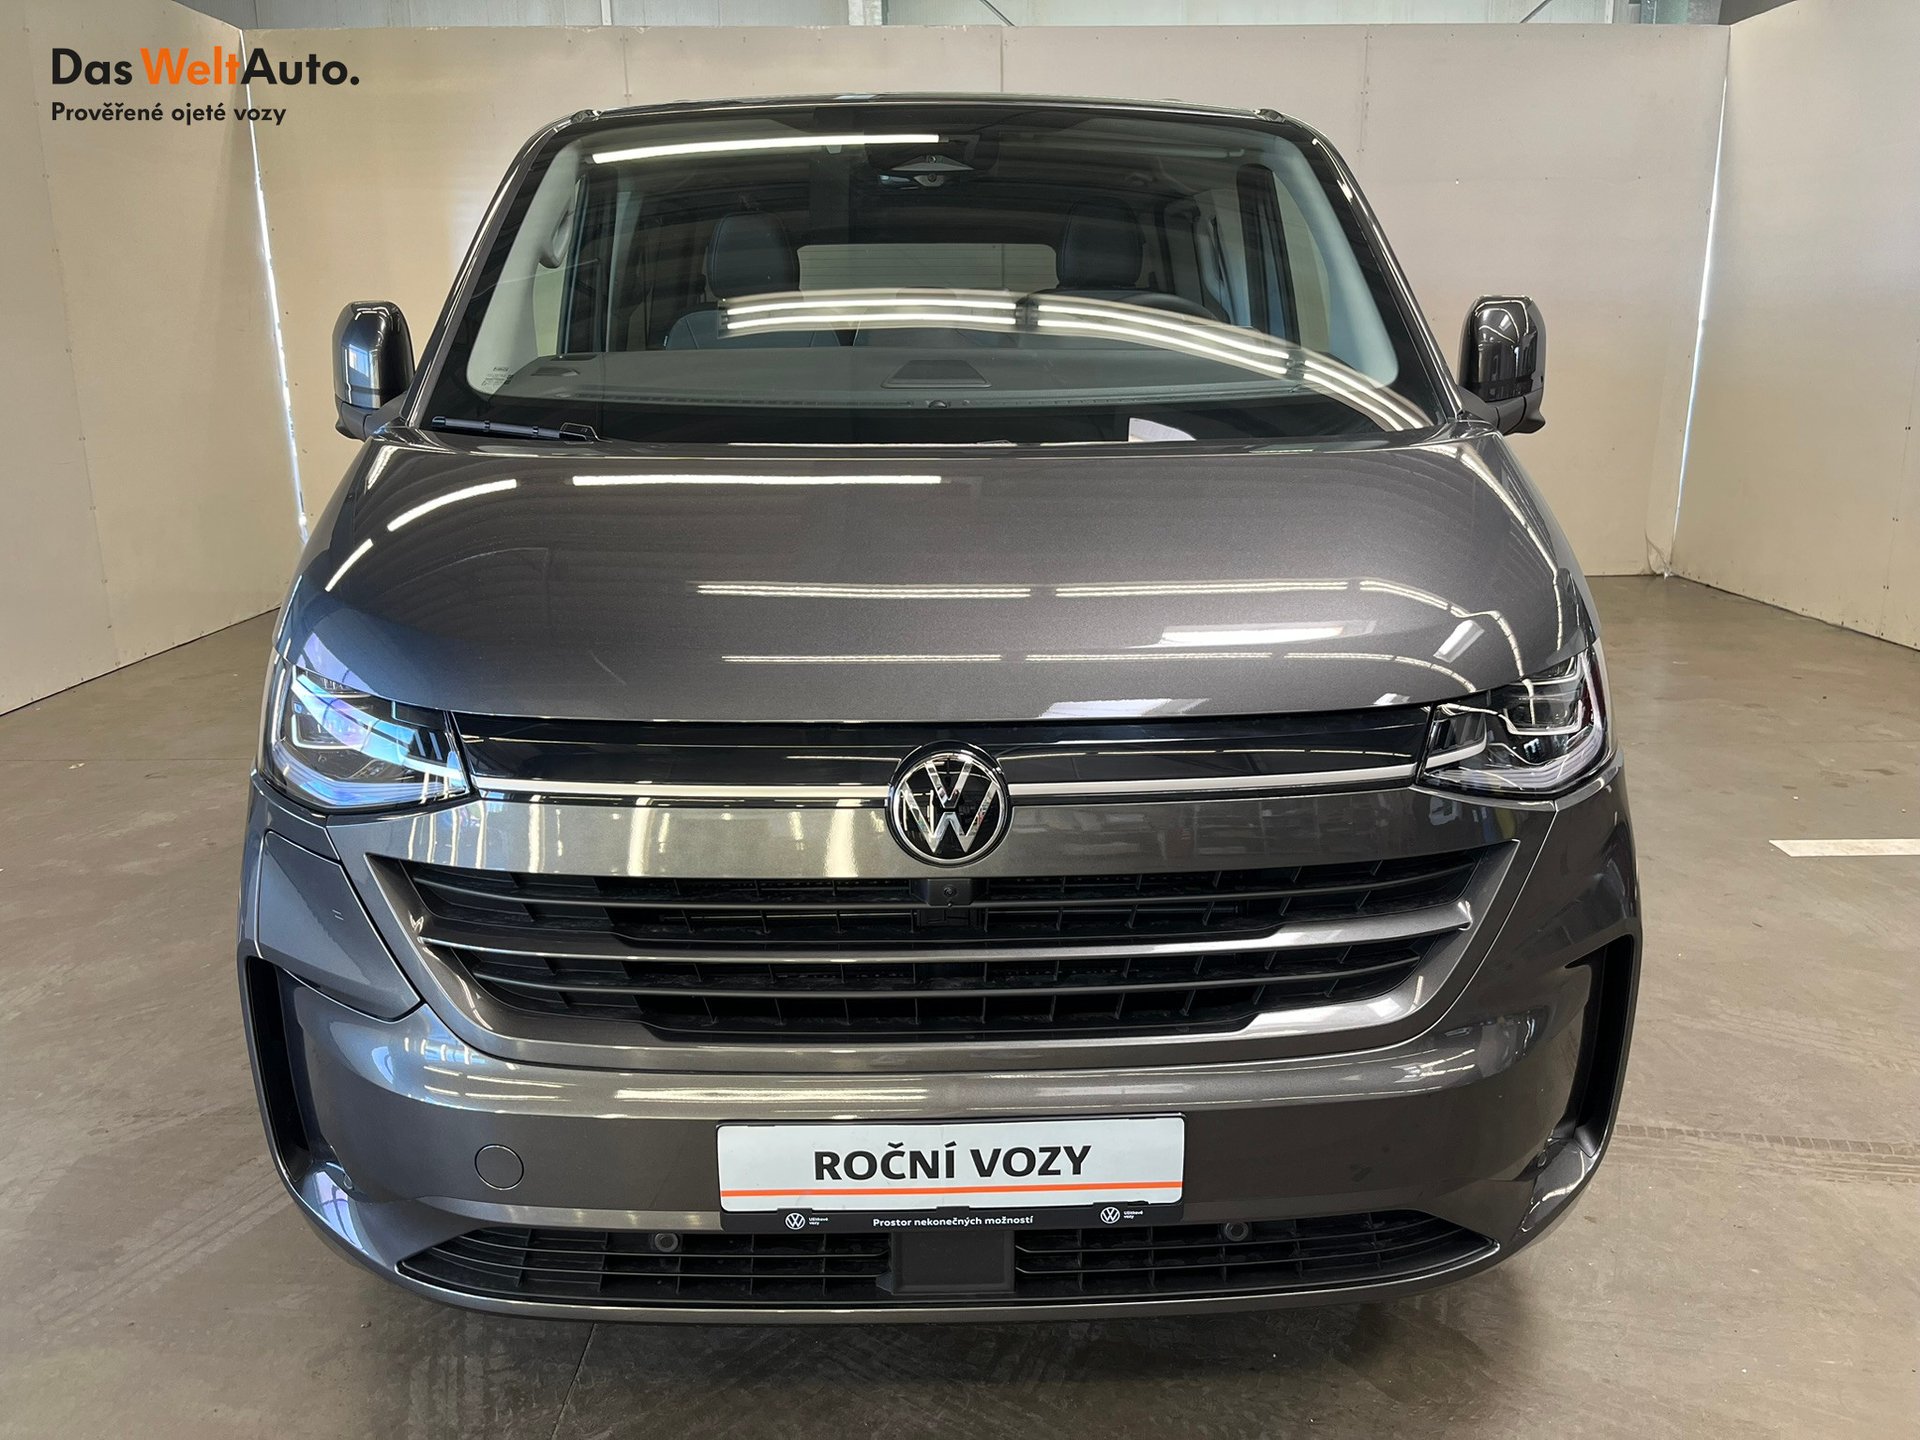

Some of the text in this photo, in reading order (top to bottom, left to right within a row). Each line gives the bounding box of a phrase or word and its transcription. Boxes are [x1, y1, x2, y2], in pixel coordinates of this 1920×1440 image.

[814, 1141, 1092, 1181] ROČNÍ VOZY
[873, 1215, 1034, 1227] Prostor nekonečných možností
